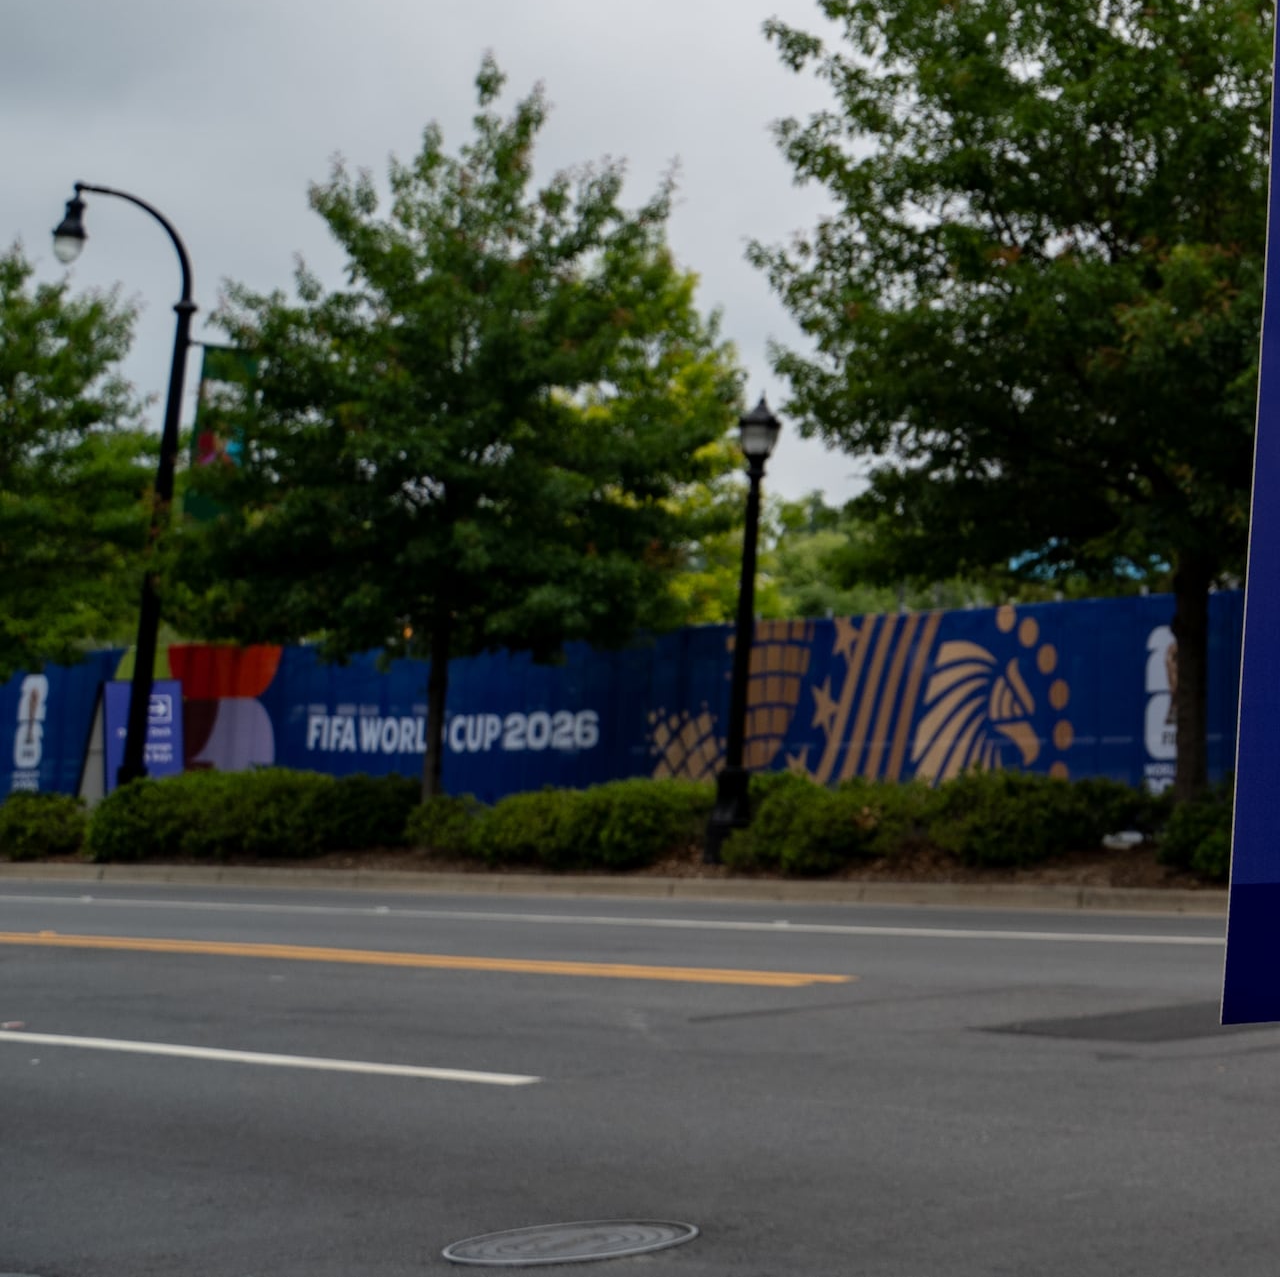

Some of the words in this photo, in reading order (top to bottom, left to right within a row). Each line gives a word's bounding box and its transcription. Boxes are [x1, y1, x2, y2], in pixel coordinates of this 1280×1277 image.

[306, 715, 357, 751] FIFA
[359, 716, 444, 754] WORL
[449, 714, 500, 752] CUP
[503, 709, 599, 751] 2026
